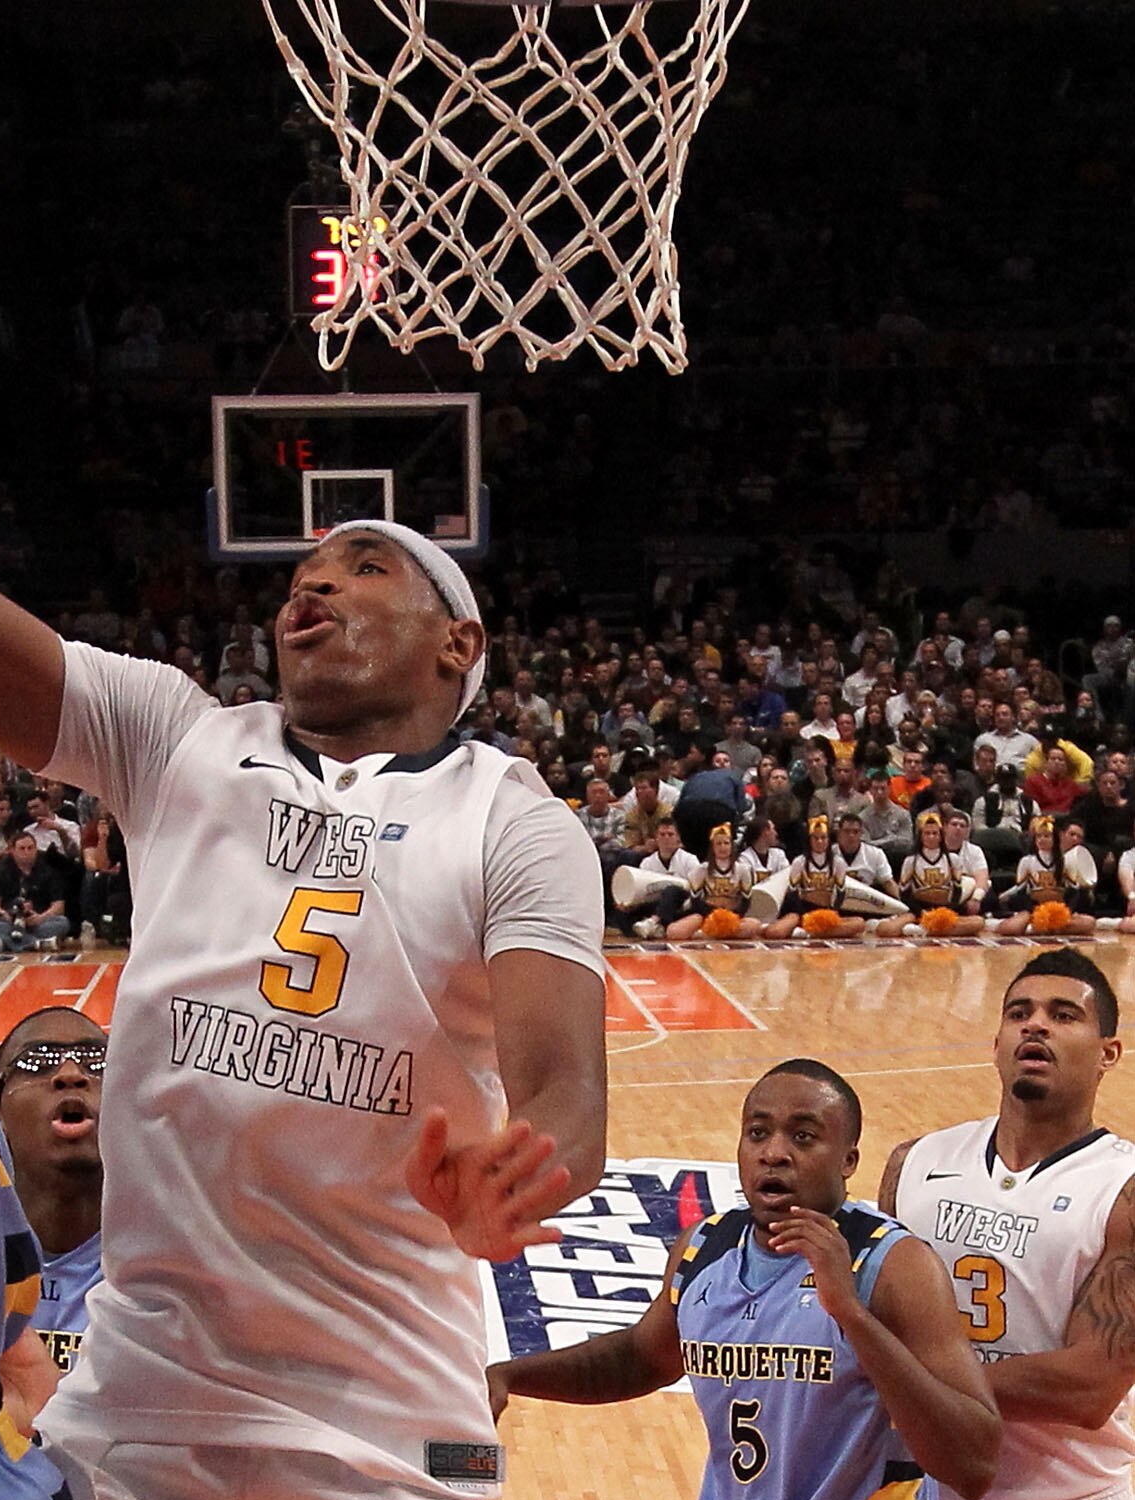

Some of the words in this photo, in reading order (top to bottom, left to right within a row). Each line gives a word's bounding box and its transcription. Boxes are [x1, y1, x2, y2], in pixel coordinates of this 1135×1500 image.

[266, 798, 376, 881] WES
[258, 886, 364, 1019] 5
[171, 996, 413, 1116] VIRGINIA
[935, 1199, 1039, 1259] WEST
[953, 1254, 1006, 1343] 3
[730, 1399, 769, 1484] 5
